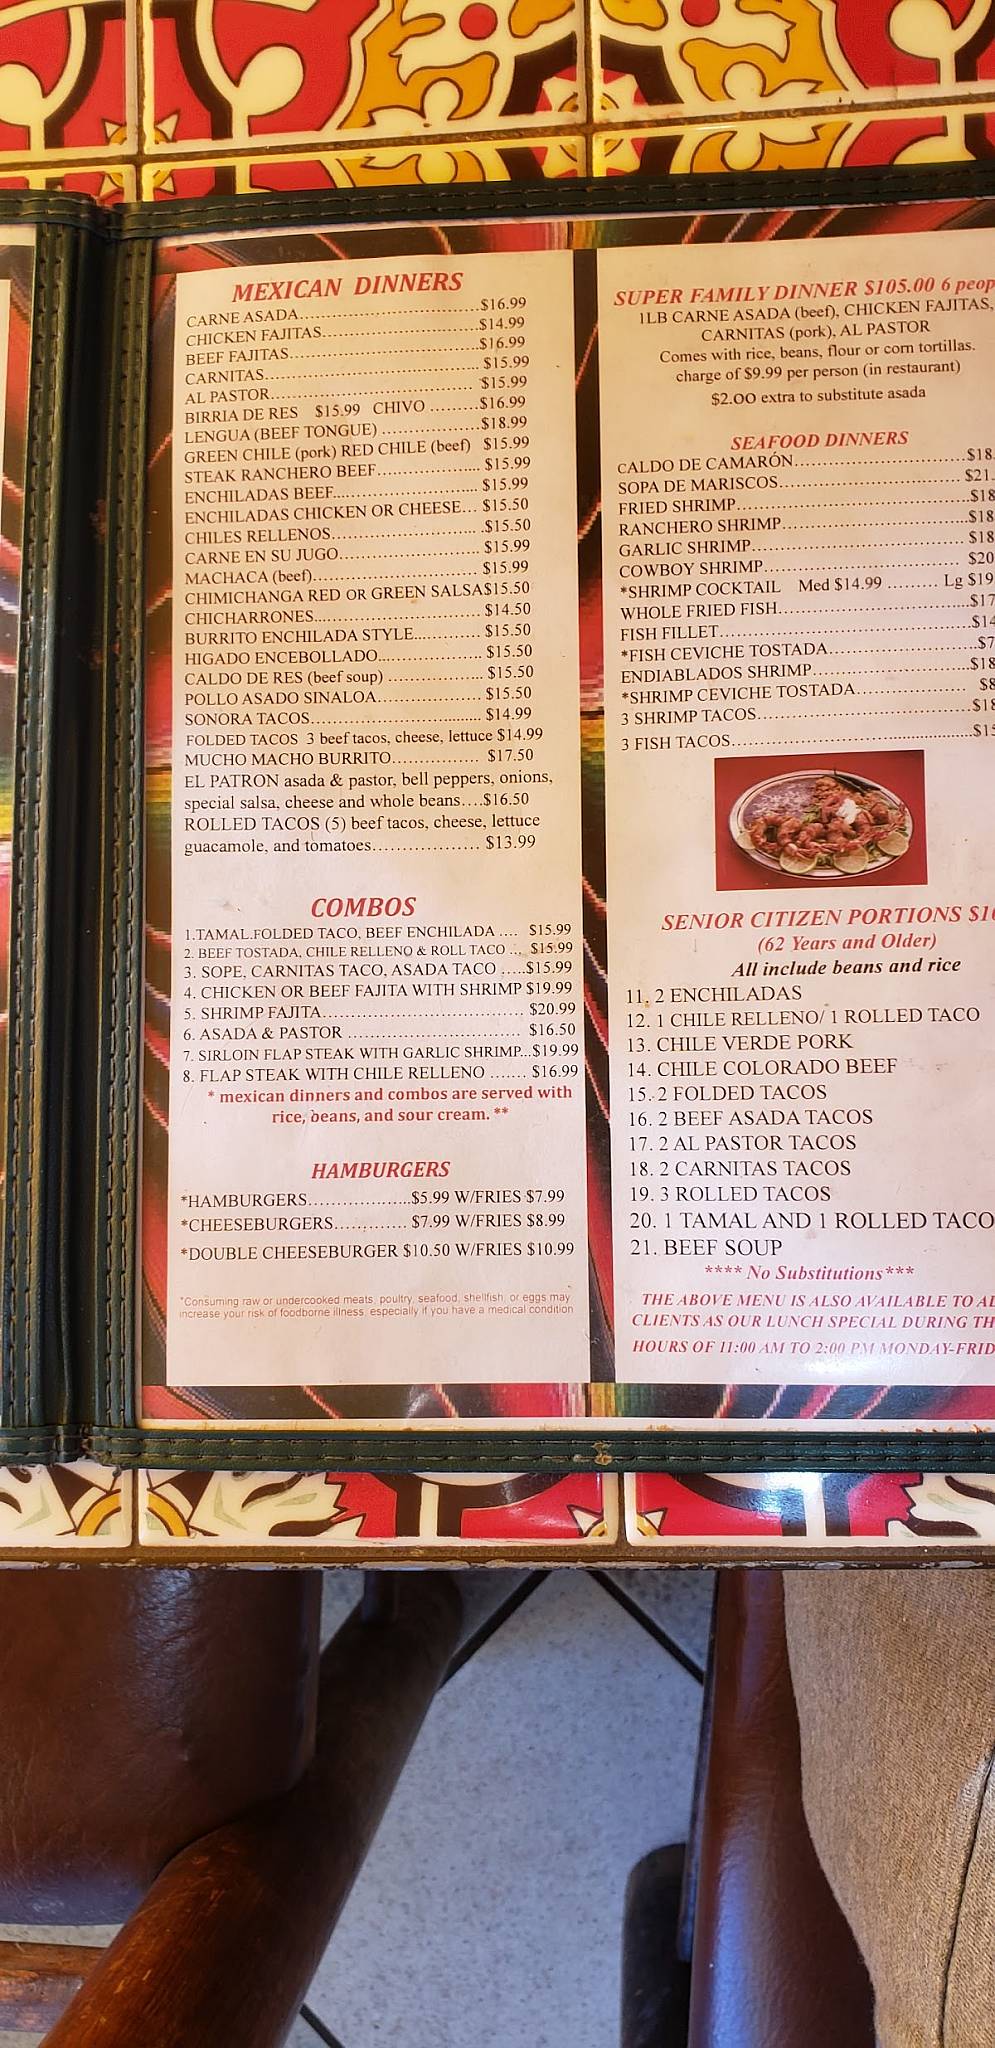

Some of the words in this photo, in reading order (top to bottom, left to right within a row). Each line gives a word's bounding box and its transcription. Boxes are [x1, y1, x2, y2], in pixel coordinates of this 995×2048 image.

[232, 279, 342, 302] MEXICAN
[354, 273, 463, 296] DINNERS
[614, 289, 682, 307] SUPER
[690, 287, 769, 303] FAMILY
[776, 282, 857, 300] DINNER
[864, 278, 935, 296] $105.00
[672, 309, 729, 323] CARNE
[733, 308, 790, 321] ASADA
[795, 305, 839, 320] (beef),
[844, 301, 921, 316] CHICKEN
[926, 299, 993, 312] FAJITAS,
[187, 313, 244, 328] CARNE
[186, 331, 257, 347] CHICKEN
[702, 328, 785, 342] CARNITAS
[790, 325, 837, 340] (pork),
[867, 321, 930, 335] PASTOR
[186, 352, 224, 366] BEEF
[660, 350, 707, 363] Comes
[711, 349, 741, 361] with
[746, 348, 776, 361] rice,
[780, 345, 823, 360] beans,
[828, 344, 861, 358] flour
[919, 339, 975, 353] tortillas.
[676, 368, 721, 384] charge
[744, 366, 782, 380] $9.99
[813, 366, 858, 380] person
[887, 360, 960, 376] restaurant)
[761, 392, 795, 403] extra
[817, 388, 883, 401] substitute
[888, 387, 926, 398] asada
[184, 409, 239, 424] BIRRIA
[243, 408, 265, 421] DE
[269, 407, 298, 419] RES
[315, 404, 360, 418] $15.99
[373, 400, 425, 415] CHIVO
[184, 427, 251, 444] LENGUA
[254, 427, 300, 442] (BEEF
[305, 423, 378, 439] TONGUE)
[731, 434, 820, 451] SEAFOOD
[826, 431, 908, 448] DINNERS
[184, 447, 239, 464] GREEN
[243, 446, 291, 461] CHILE
[296, 443, 336, 461] (pork)
[342, 443, 374, 457] RED
[379, 441, 426, 456] CHILE
[431, 439, 471, 454] (beef)
[483, 436, 529, 451] $15.99
[184, 508, 290, 525] ENCHILADAS
[294, 504, 366, 519] CHICKEN
[483, 498, 529, 512] $15.50
[184, 570, 268, 585] MACHACA
[483, 560, 529, 575] $15.99
[619, 563, 694, 578] COWBOY
[184, 587, 303, 605] CHIMICHANGA
[308, 587, 340, 602] RED
[371, 584, 426, 600] GREEN
[696, 582, 781, 596] COCKTAIL
[799, 579, 829, 592] Med
[834, 577, 882, 591] $14.99
[621, 606, 682, 621] WHOLE
[687, 605, 735, 618] FRIED
[184, 630, 258, 645] BURRITO
[262, 628, 359, 643] ENCHILADA
[184, 672, 242, 686] CALDO
[307, 669, 344, 685] (beef
[346, 669, 383, 685] soup)
[186, 733, 246, 746] FOLDED
[251, 732, 298, 746] TACOS
[320, 731, 350, 744] beef
[352, 731, 391, 745] tacos,
[395, 730, 443, 745] cheese,
[449, 729, 492, 743] lettuce
[497, 728, 543, 742] $14.99
[184, 752, 247, 767] MUCHO
[251, 752, 314, 766] MACHO
[488, 748, 533, 762] $17.50
[210, 773, 279, 788] PATRON
[284, 774, 325, 788] asada
[402, 770, 429, 786] bell
[433, 772, 495, 788] peppers,
[500, 770, 553, 786] onions,
[311, 897, 416, 917] COMBOS
[662, 913, 743, 930] SENIOR
[750, 910, 840, 928] CITIZEN
[848, 907, 962, 925] PORTIONS
[366, 926, 402, 938] BEEF
[407, 925, 494, 937] ENCHILADA
[529, 924, 571, 936] $15.99
[306, 946, 347, 957] CHILE
[350, 945, 413, 956] RELLENO
[431, 945, 466, 955] ROLL
[469, 944, 505, 955] TACO
[792, 936, 836, 951] Years
[842, 935, 876, 949] and
[882, 933, 937, 948] Older)
[732, 962, 757, 978] All
[763, 962, 828, 976] include
[832, 960, 883, 974] beans
[889, 958, 923, 972] and
[928, 958, 961, 971] rice
[201, 985, 276, 999] CHICKEN
[309, 985, 350, 998] BEEF
[355, 984, 408, 997] FAJITA
[412, 983, 455, 996] WITH
[460, 982, 522, 996] SHRIMP
[526, 981, 572, 996] $19.99
[671, 986, 802, 1002] ENCHILADAS
[657, 1037, 716, 1051] CHILE
[722, 1035, 791, 1050] VERDE
[798, 1034, 853, 1049] PORK
[723, 1059, 840, 1075] COLORADO
[846, 1058, 898, 1073] BEEF
[220, 1089, 285, 1103] mexican
[290, 1088, 350, 1101] dinners
[355, 1088, 383, 1101] and
[388, 1087, 448, 1100] combos
[482, 1086, 532, 1099] served
[364, 1109, 394, 1122] and
[398, 1111, 433, 1121] sour
[438, 1109, 490, 1121] cream.
[311, 1162, 451, 1179] HAMBURGERS
[675, 1161, 777, 1177] CARNITAS
[785, 1161, 851, 1176] TACOS
[455, 1190, 522, 1203] W/FRIES
[527, 1190, 565, 1203] $7.99
[455, 1214, 522, 1227] W/FRIES
[527, 1214, 565, 1227] $8.99
[262, 1245, 398, 1259] CHEESEBURGER
[403, 1243, 450, 1258] $10.50
[455, 1243, 522, 1257] W/FRIES
[527, 1242, 574, 1257] $10.99
[664, 1240, 718, 1255] BEEF
[725, 1240, 782, 1255] SOUP
[276, 1295, 340, 1305] undercooked
[642, 1294, 675, 1306] THE
[679, 1294, 733, 1306] ABOVE
[737, 1295, 786, 1307] MENU
[810, 1296, 852, 1307] ALSO
[855, 1296, 947, 1308] AVAILABLE
[224, 1310, 244, 1320] your
[248, 1308, 265, 1317] risk
[280, 1307, 330, 1317] foodborne
[370, 1307, 419, 1318] especially
[431, 1307, 448, 1317] you
[452, 1306, 474, 1314] have
[488, 1305, 525, 1314] medical
[529, 1304, 573, 1314] condition
[767, 1315, 824, 1328] LUNCH
[828, 1316, 897, 1328] SPECIAL
[902, 1317, 967, 1329] DURING
